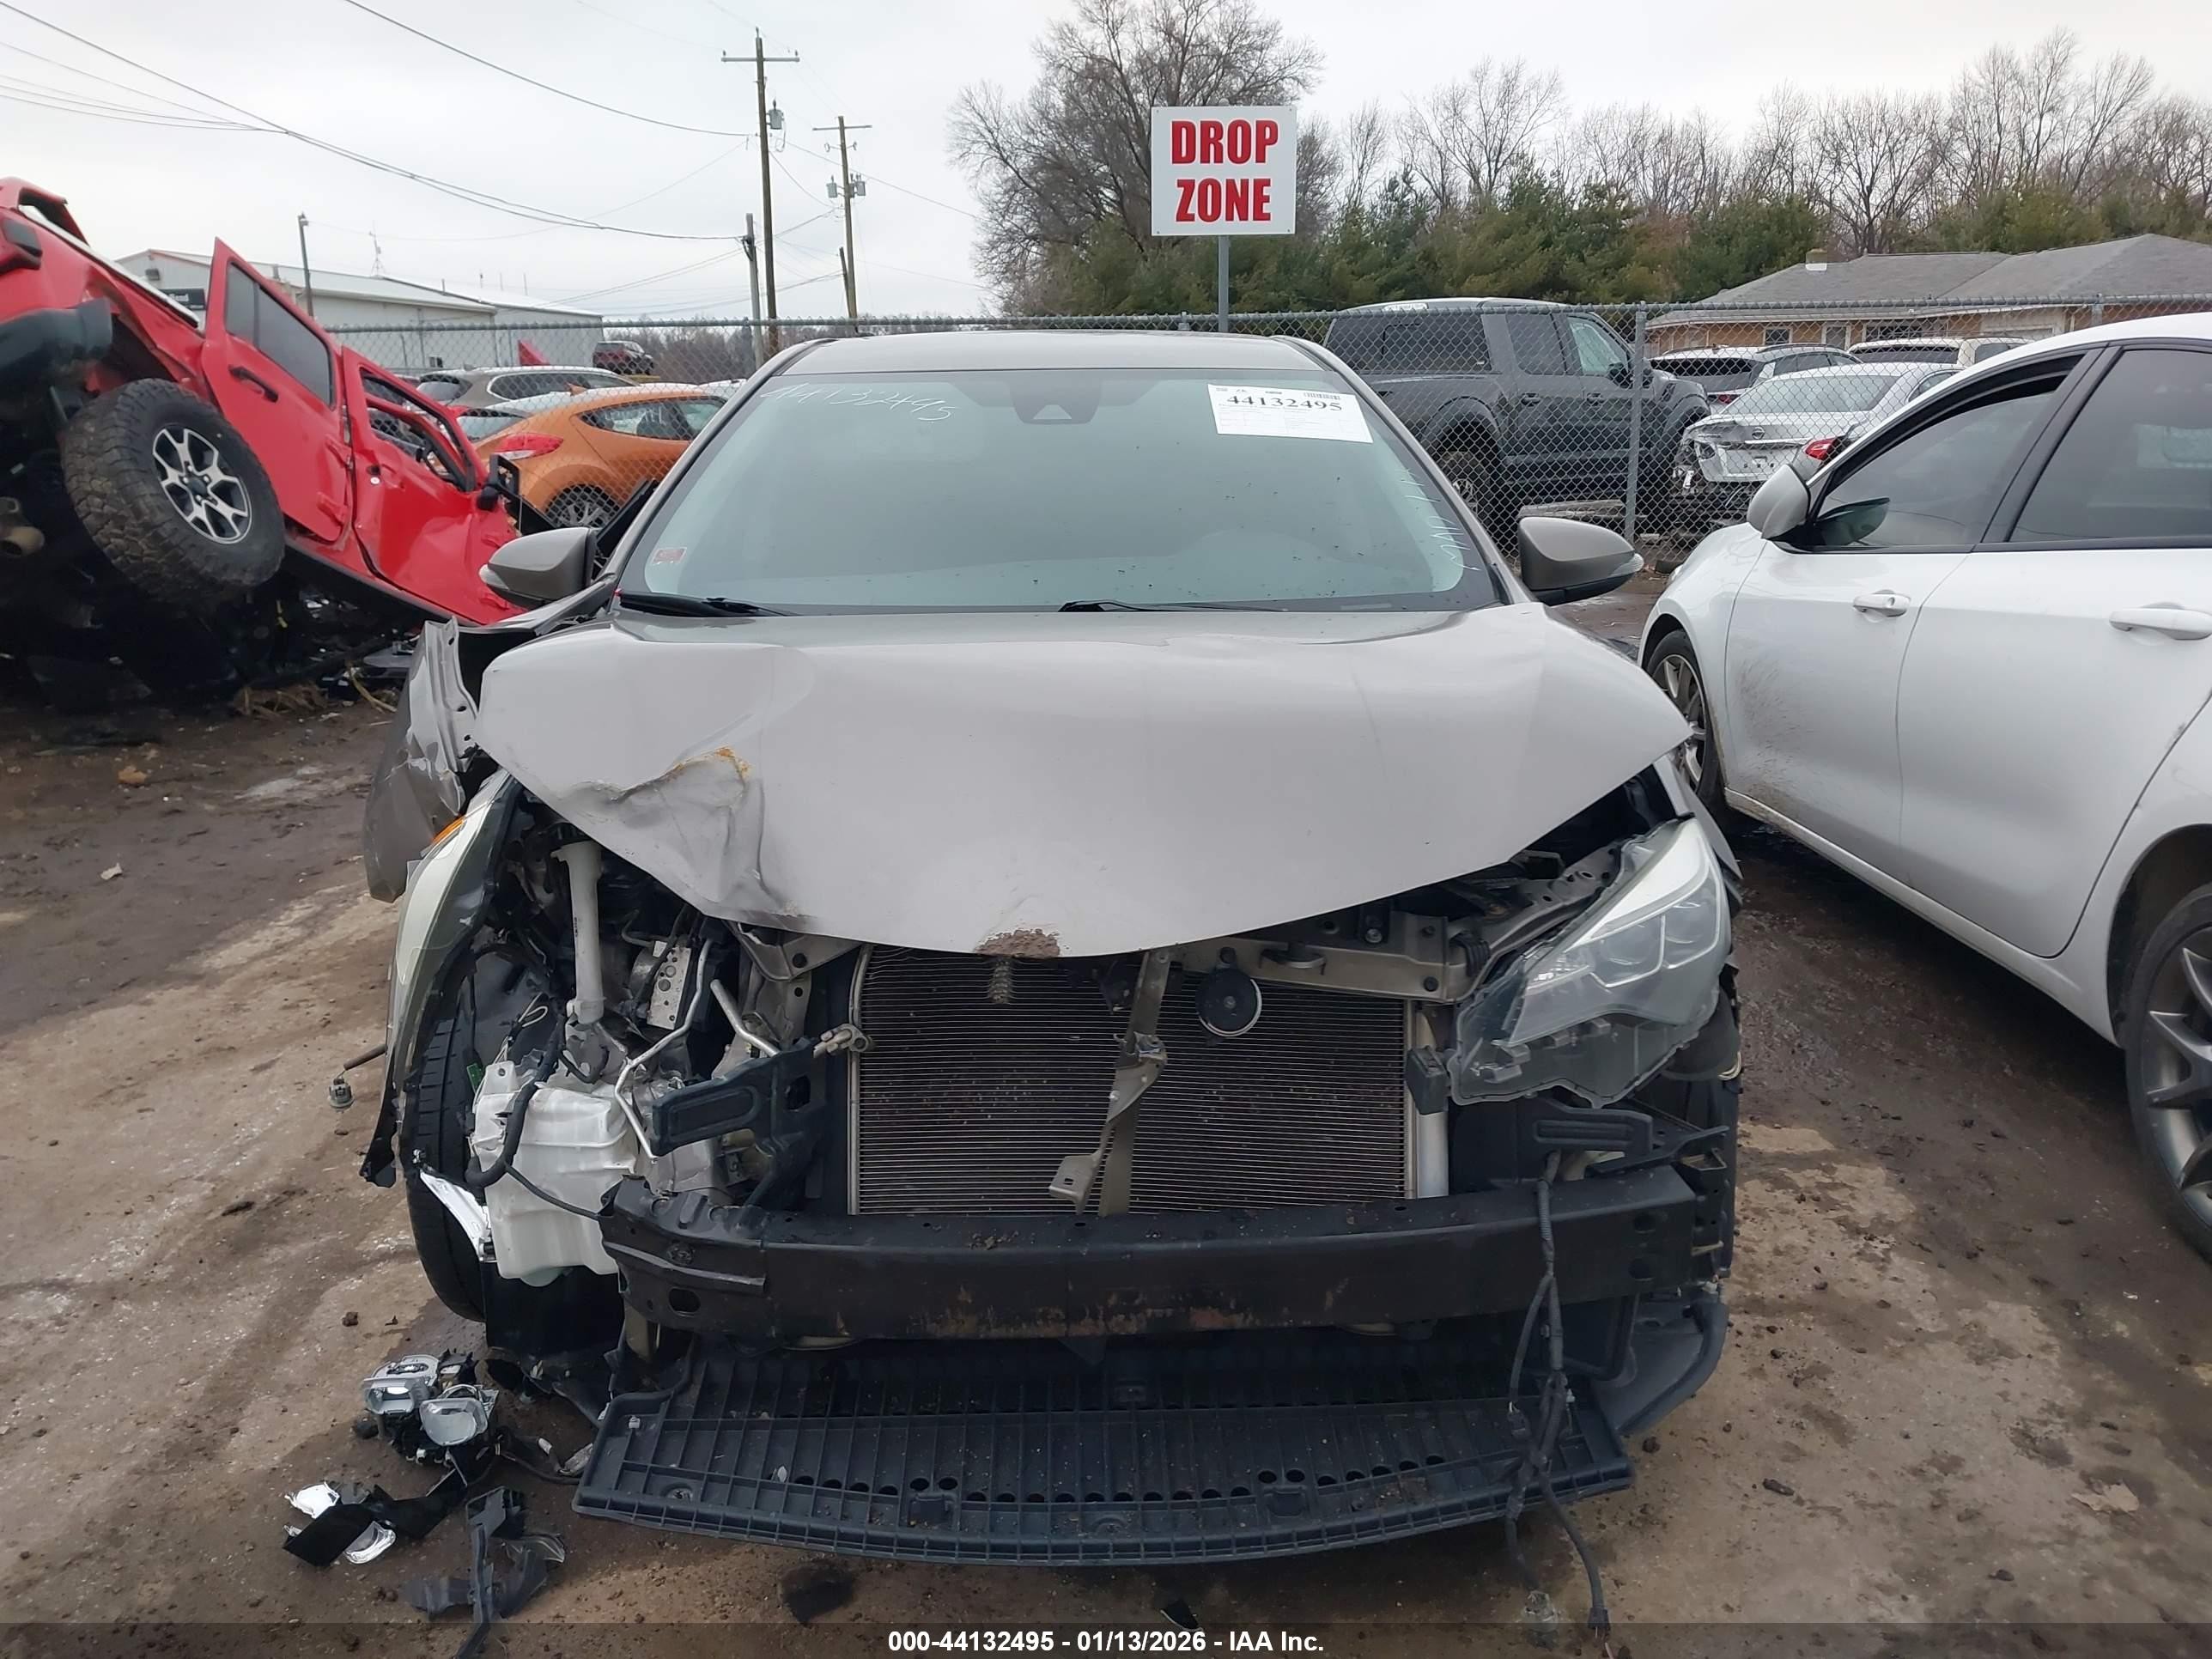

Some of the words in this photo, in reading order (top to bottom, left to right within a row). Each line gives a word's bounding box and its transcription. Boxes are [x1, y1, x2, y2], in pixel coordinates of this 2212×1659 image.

[1171, 119, 1279, 165] DROP
[1176, 178, 1272, 222] ZONE
[1226, 394, 1343, 411] 44132495
